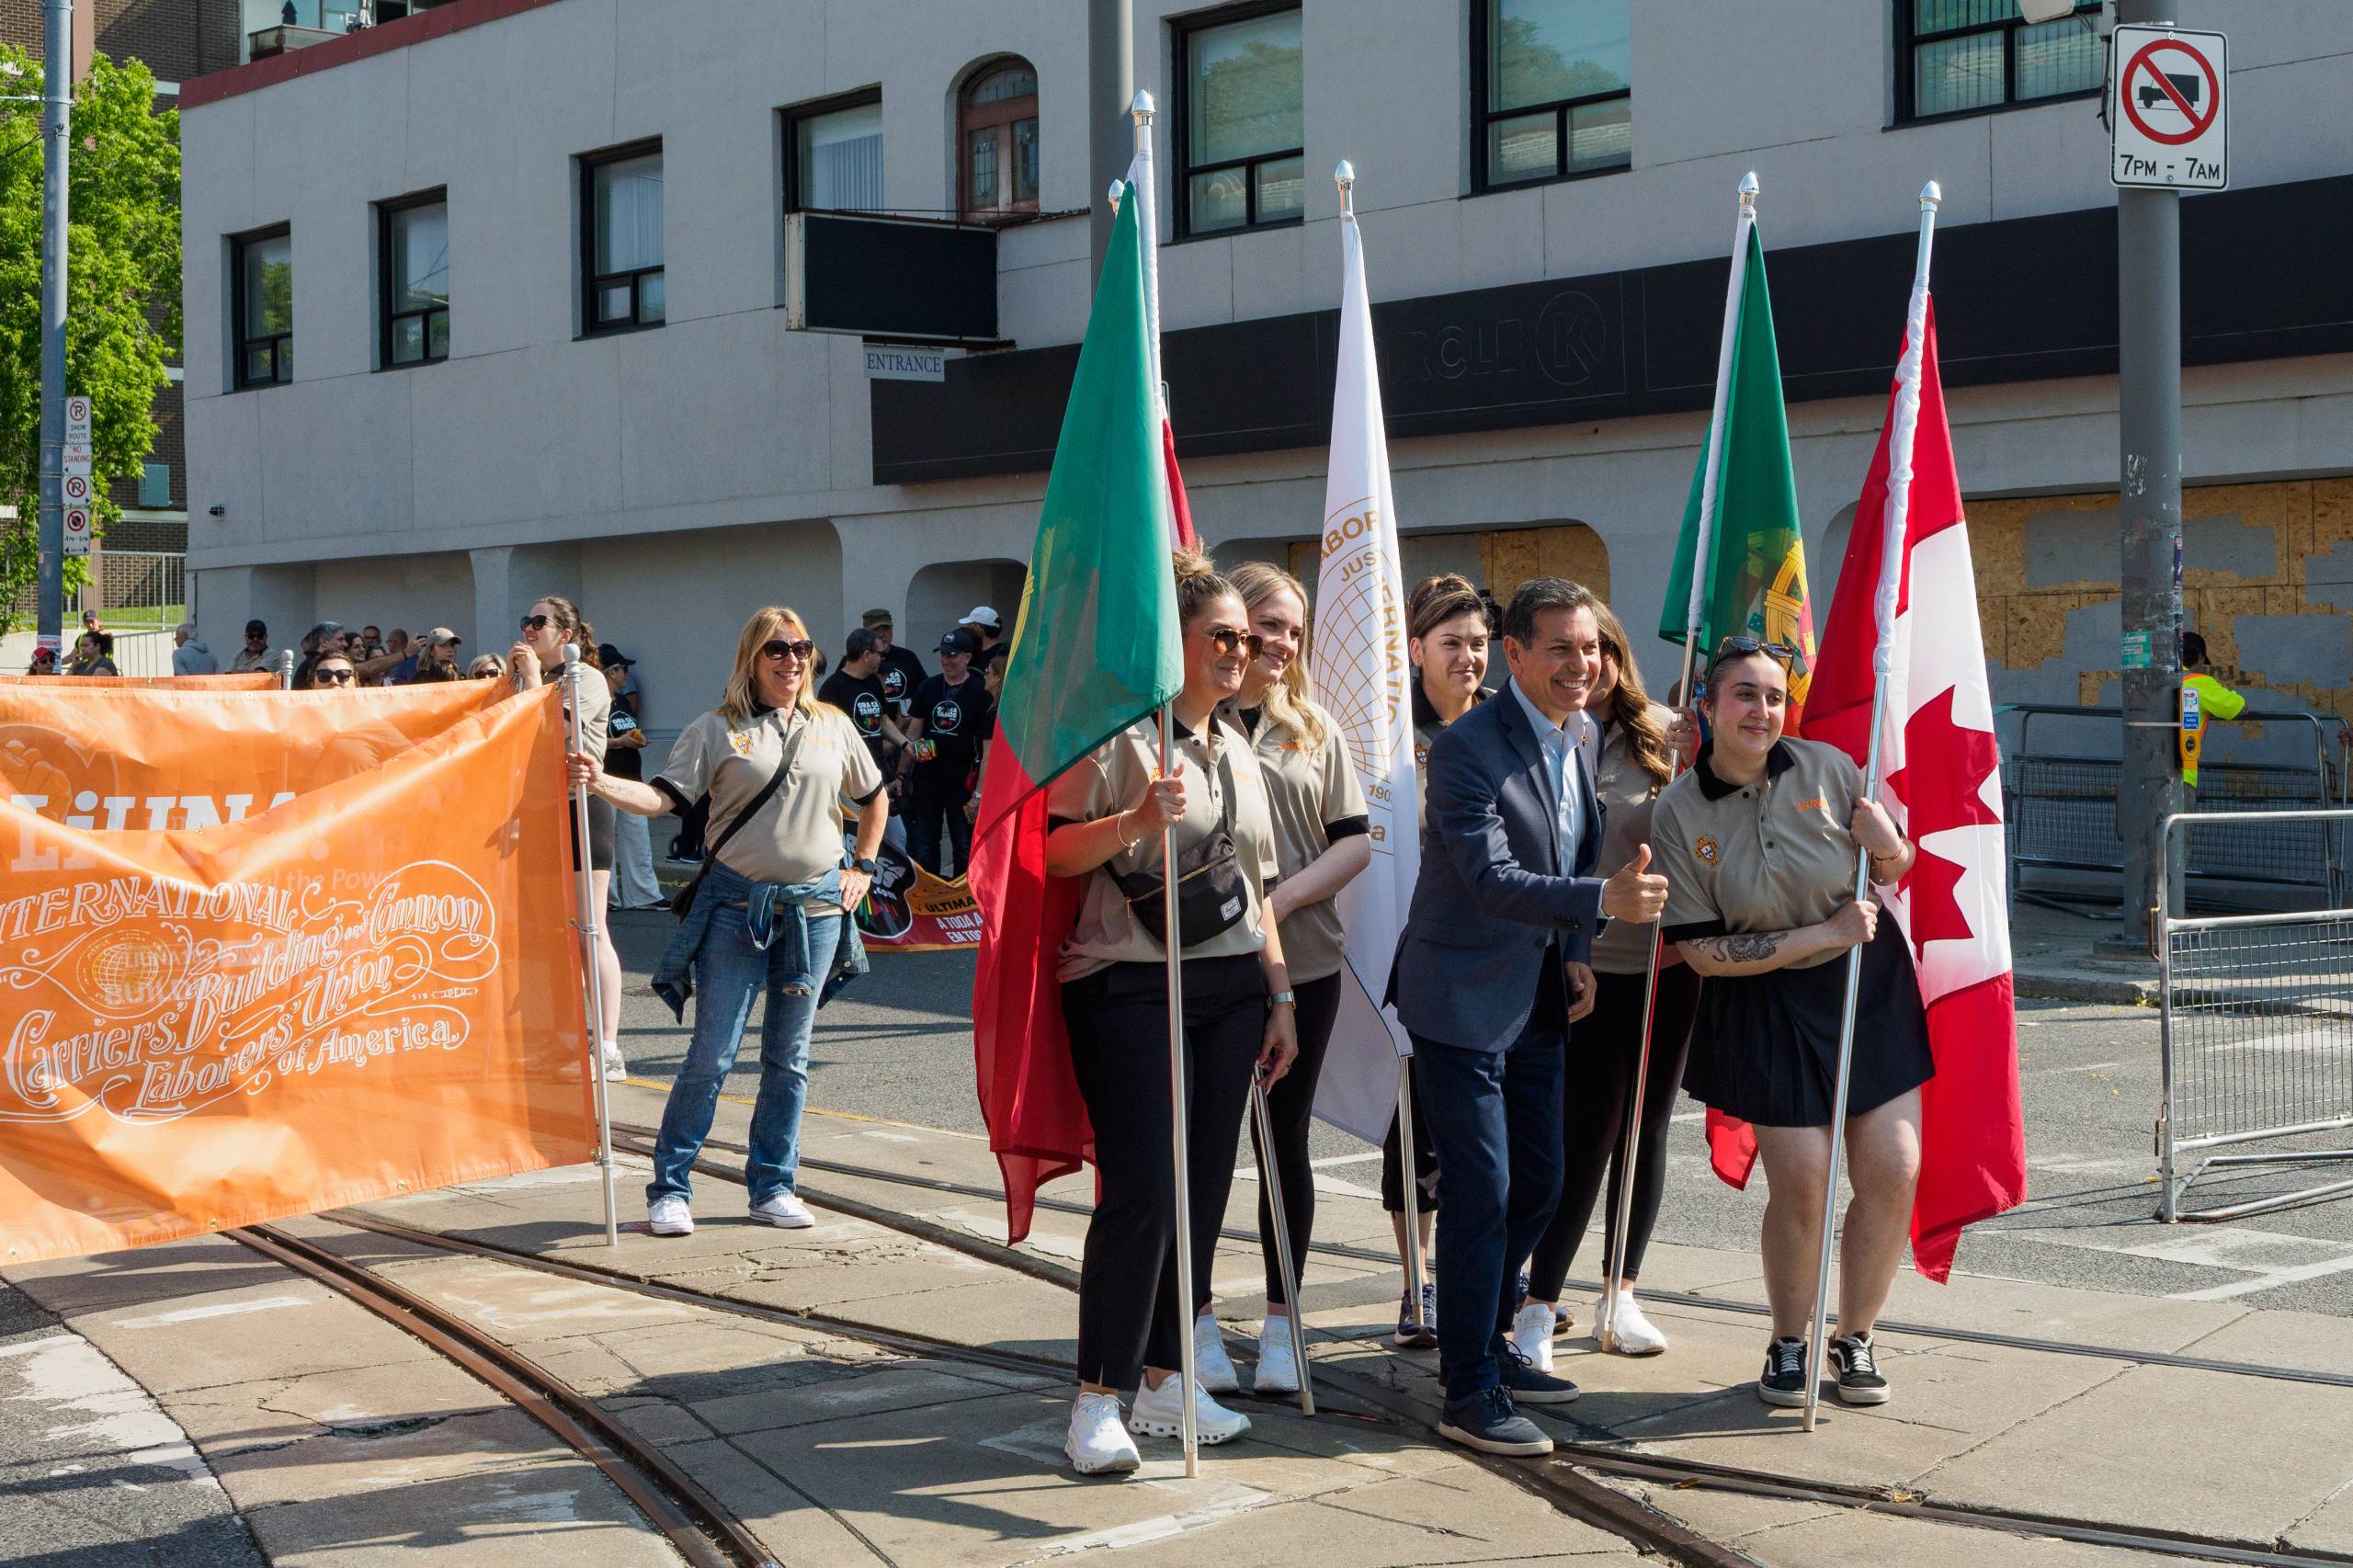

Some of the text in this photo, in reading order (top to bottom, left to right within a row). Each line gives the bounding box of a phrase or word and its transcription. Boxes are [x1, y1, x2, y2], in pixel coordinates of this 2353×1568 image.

[2120, 154, 2157, 176] 7PM
[2185, 157, 2221, 180] 7AM
[867, 353, 942, 373] ENTRANCE
[63, 454, 91, 463] STANDING
[73, 445, 82, 453] NO
[942, 915, 975, 929] TODA
[945, 930, 968, 943] EM
[174, 914, 344, 1054] Building
[369, 881, 484, 949] Common
[301, 953, 394, 1032] Union
[277, 1038, 314, 1075] of
